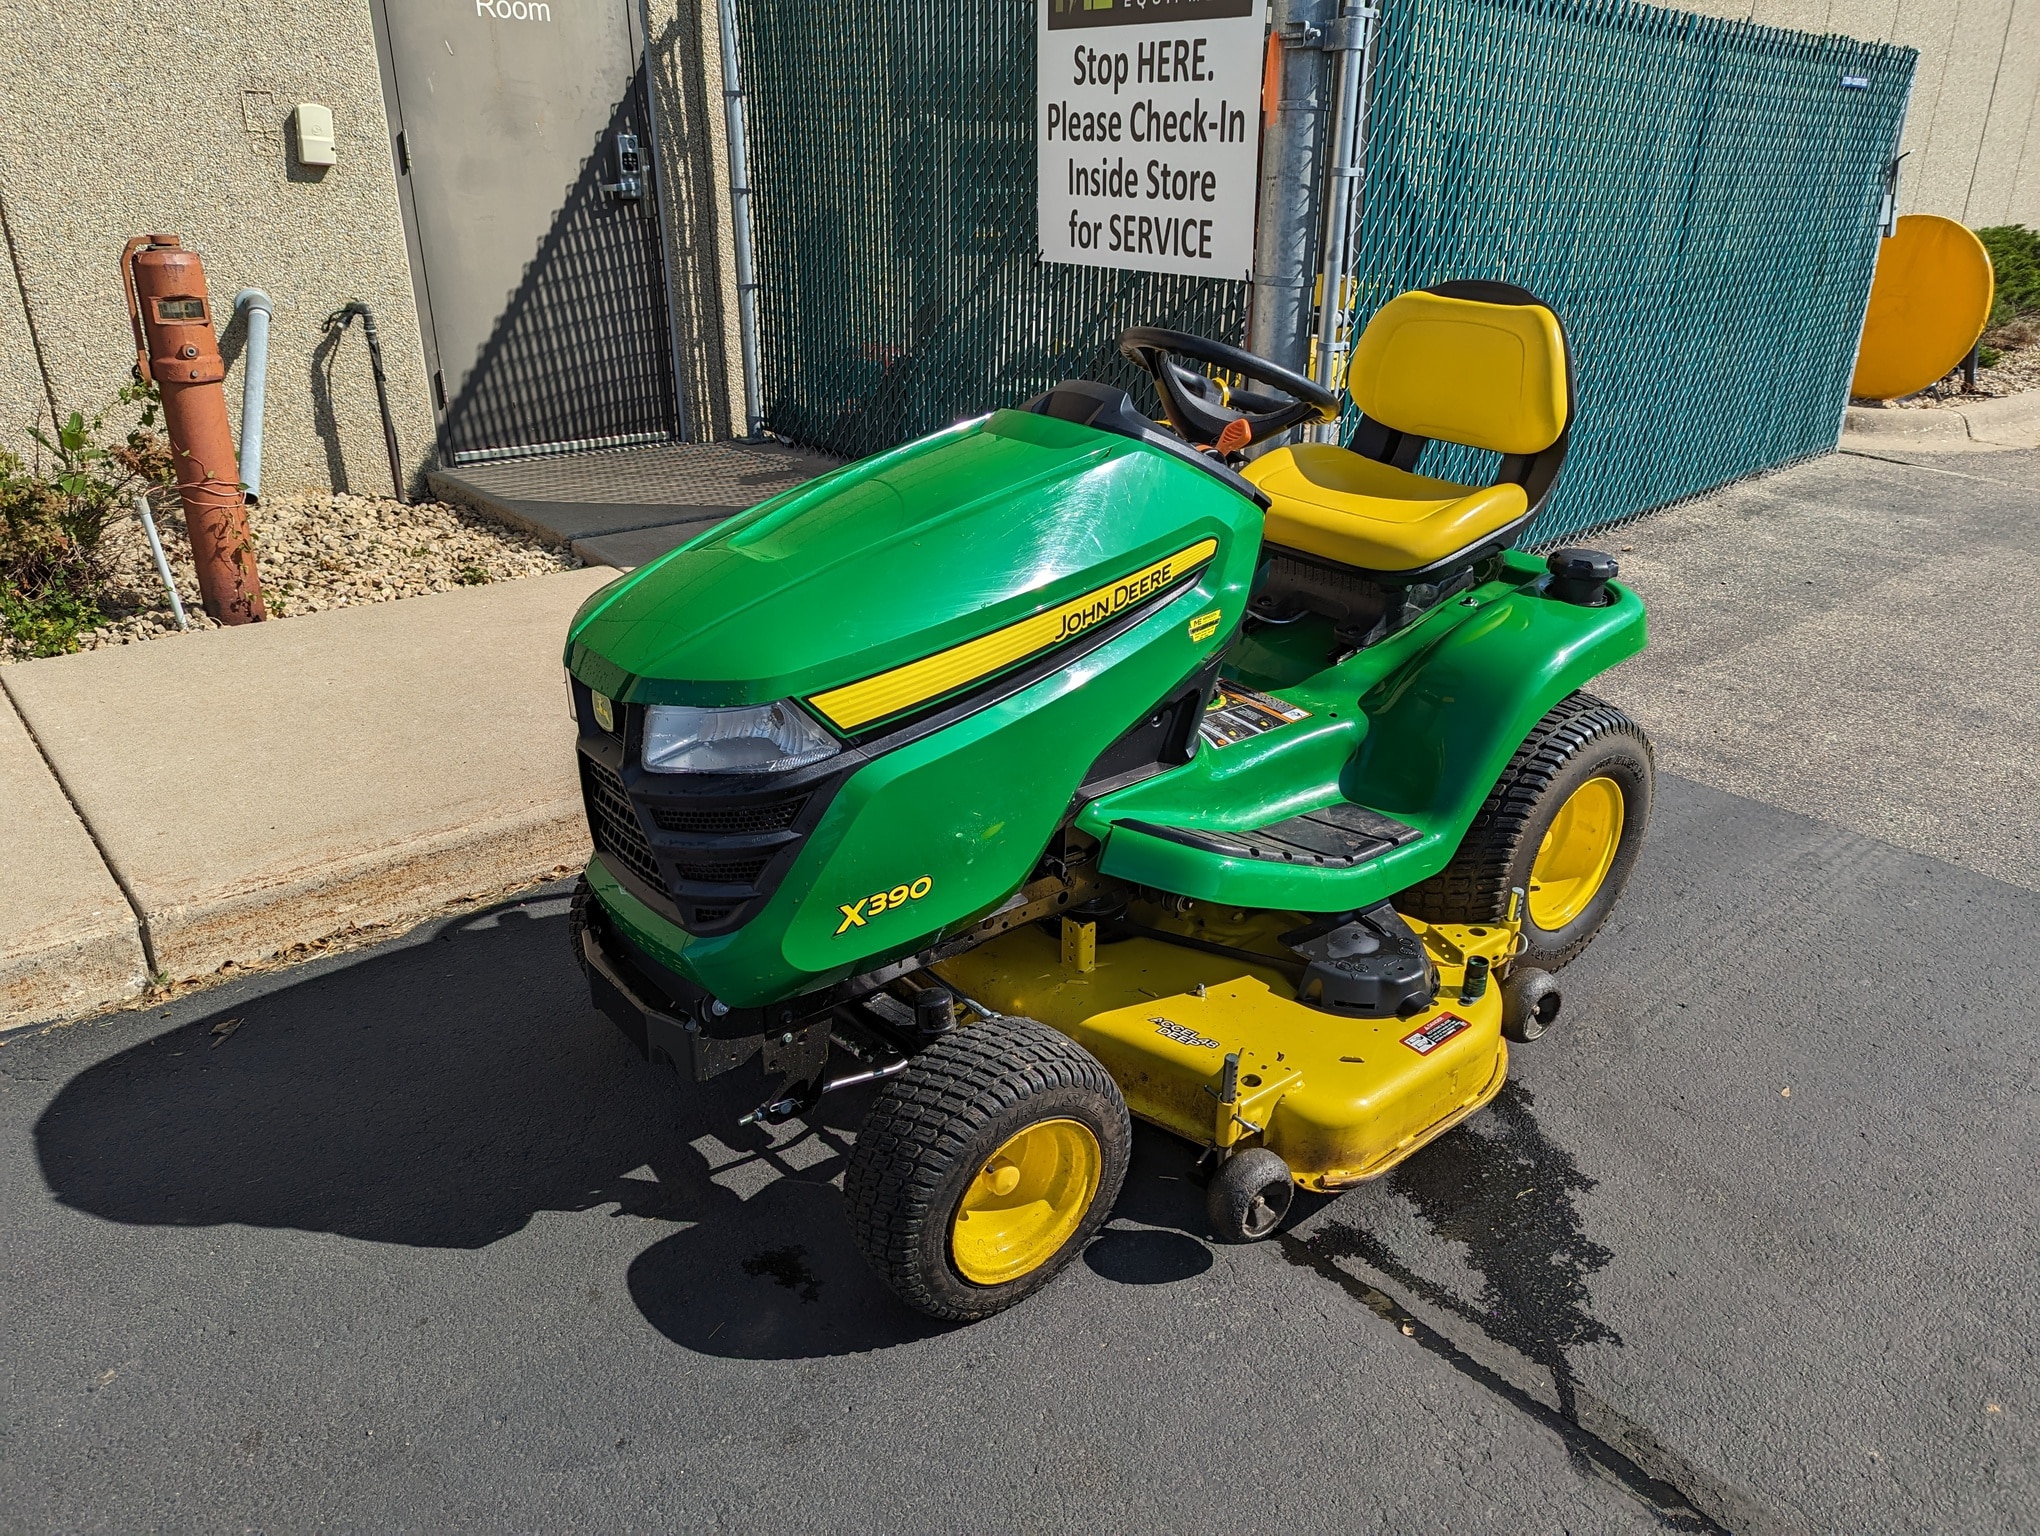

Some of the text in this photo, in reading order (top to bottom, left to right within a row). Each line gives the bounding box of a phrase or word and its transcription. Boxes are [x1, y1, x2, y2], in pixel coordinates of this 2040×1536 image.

[475, 0, 551, 22] Room
[1073, 38, 1214, 95] Stop HERE.
[1047, 98, 1245, 143] Please Check-In
[1068, 156, 1216, 202] Inside Store
[1069, 209, 1213, 259] for SERVICE
[1055, 562, 1174, 641] JOHN DEERE
[833, 875, 933, 937] X390
[1148, 1017, 1200, 1042] ACCEL
[1155, 1027, 1201, 1047] DEEP
[976, 1092, 1106, 1153] CARLISLE
